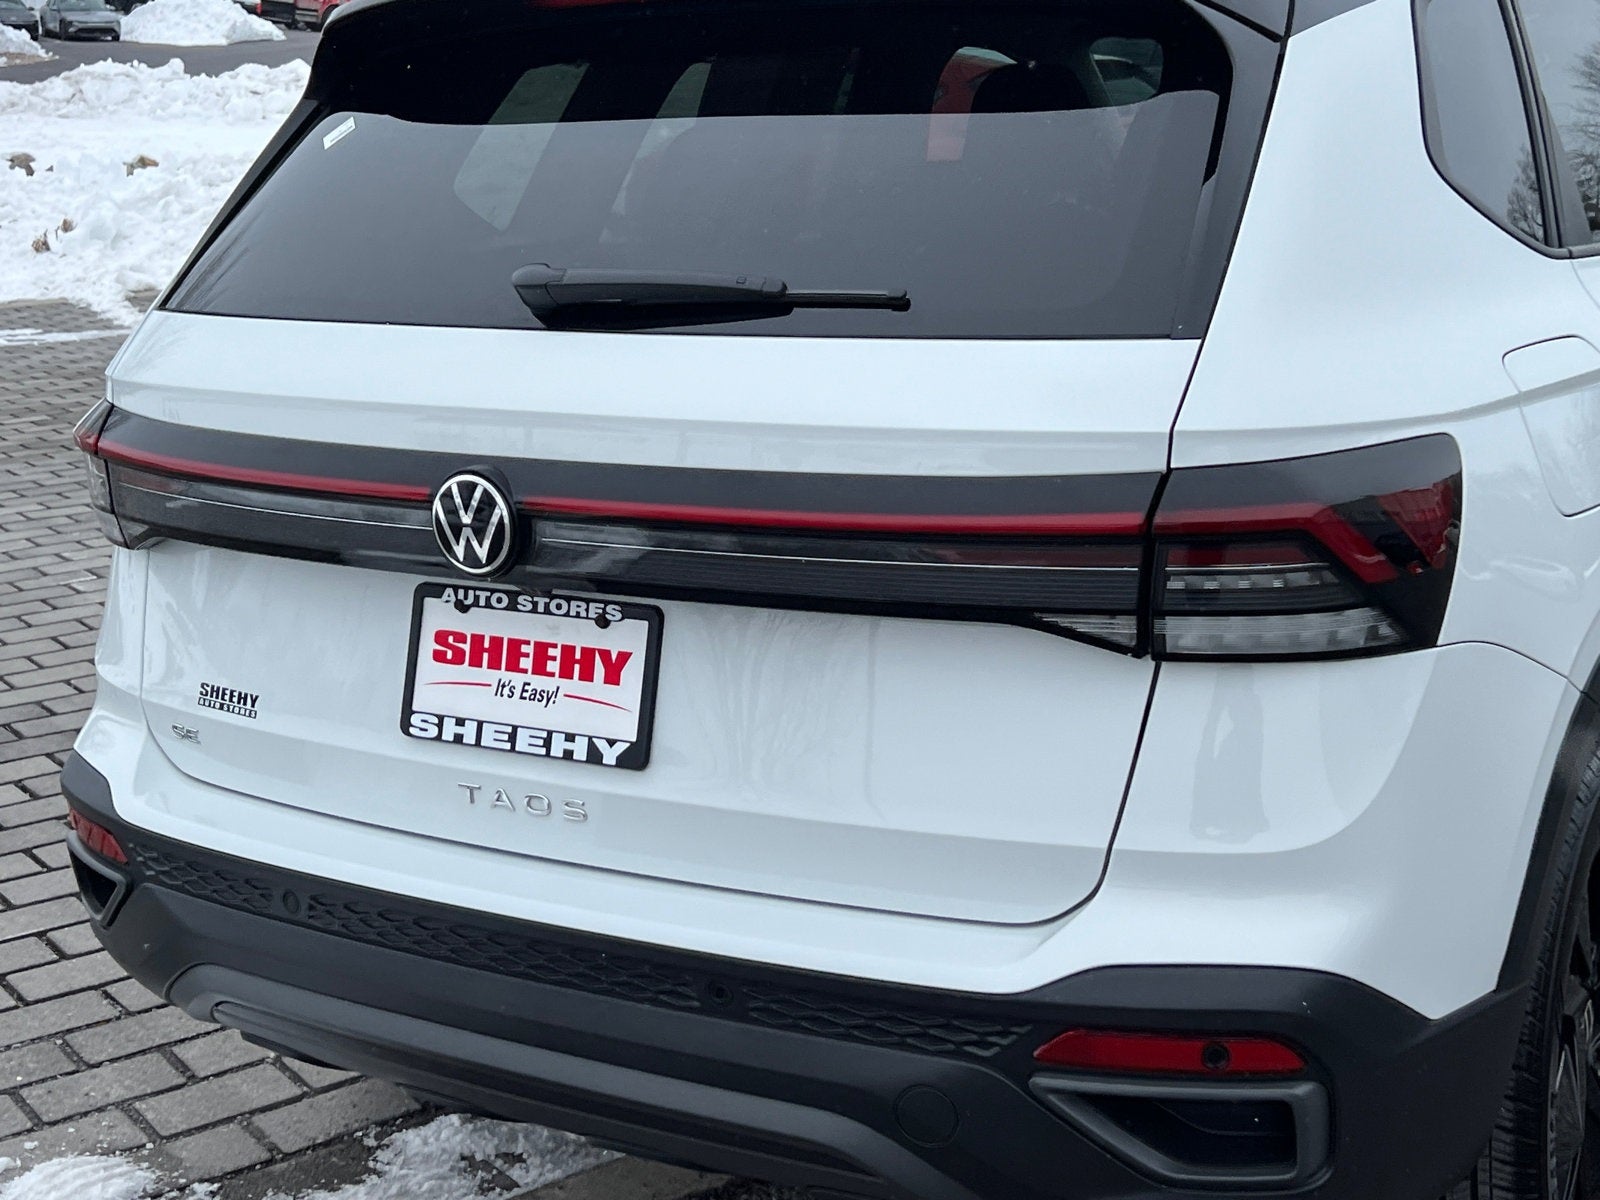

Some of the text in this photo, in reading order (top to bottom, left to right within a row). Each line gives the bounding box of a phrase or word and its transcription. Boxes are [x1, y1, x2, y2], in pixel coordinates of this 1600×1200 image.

[441, 587, 623, 621] AUTO STORES
[432, 629, 633, 686] SHEEHY
[198, 696, 257, 719] AUTO STORES
[199, 682, 260, 709] SHEEHY
[494, 678, 560, 708] It's Easy!
[171, 723, 201, 745] SE
[409, 712, 631, 766] SHEEHY
[457, 783, 588, 822] TAOS
